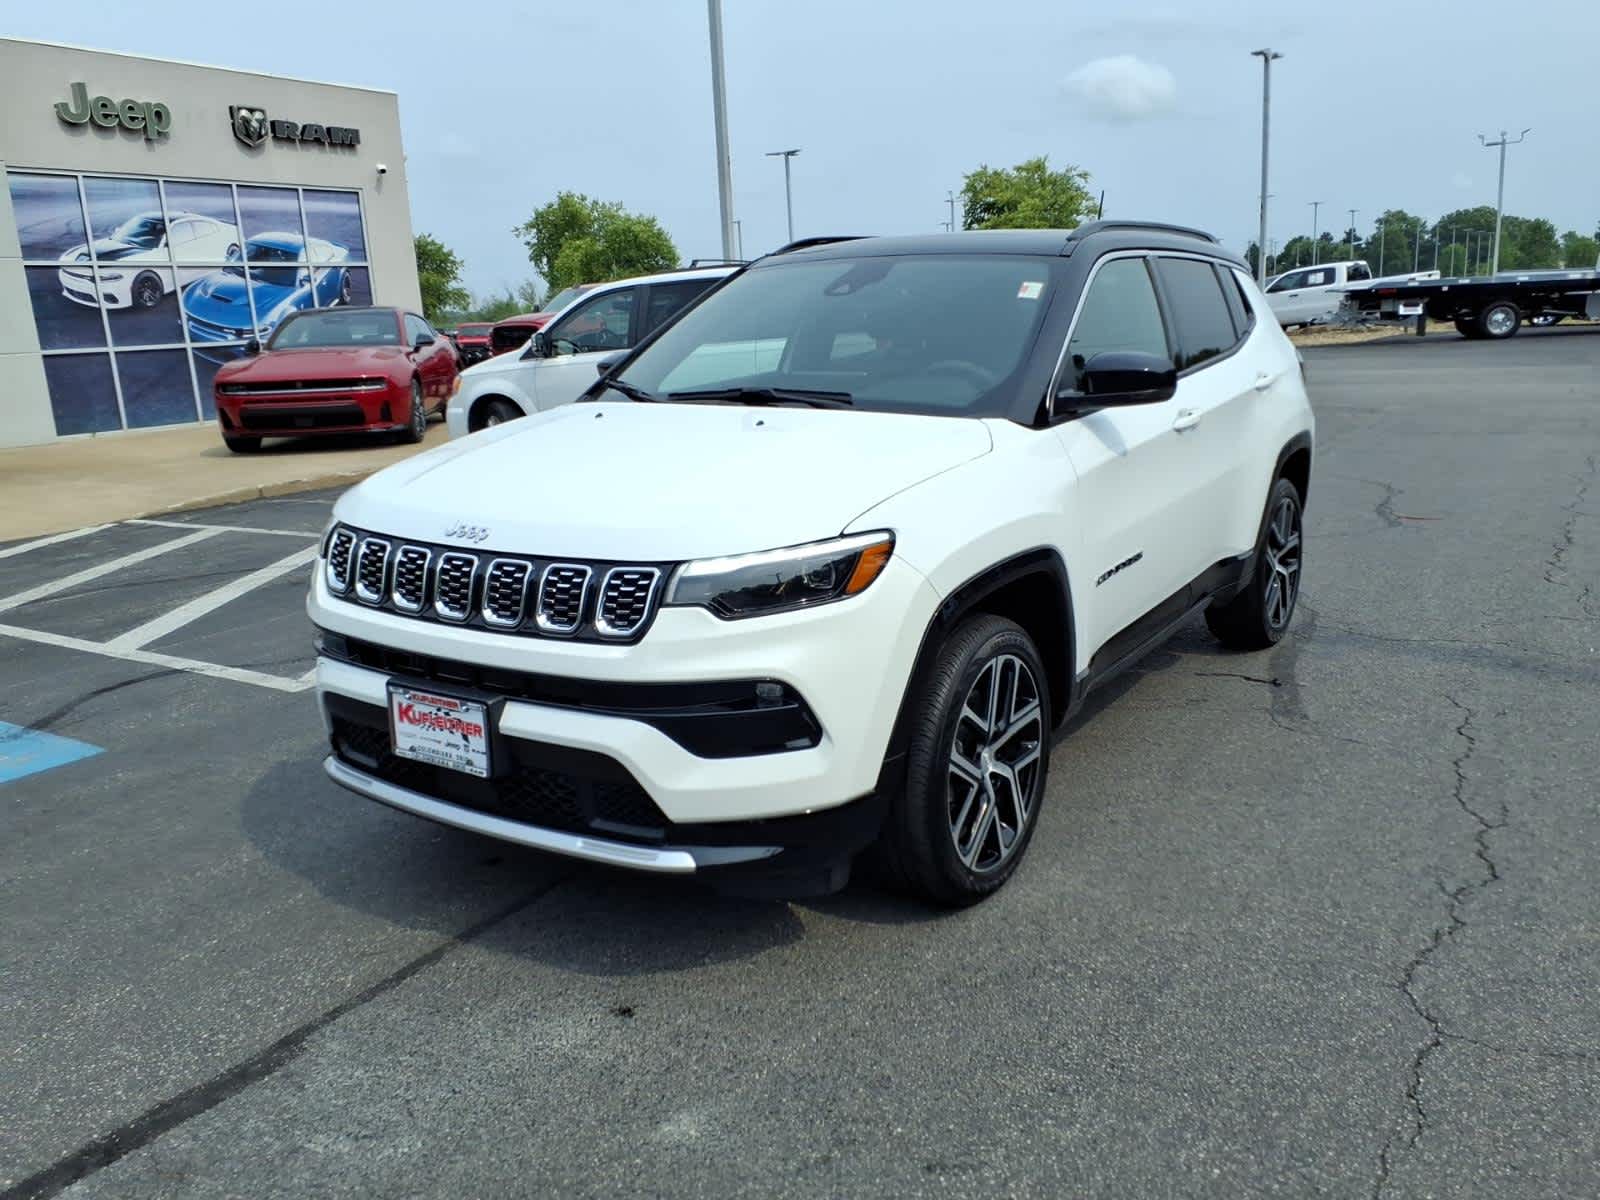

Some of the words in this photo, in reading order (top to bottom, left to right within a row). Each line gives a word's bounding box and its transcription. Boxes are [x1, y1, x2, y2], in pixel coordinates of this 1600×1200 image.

[54, 82, 171, 140] Jeep
[269, 119, 361, 145] RAM
[445, 519, 490, 544] Jeep
